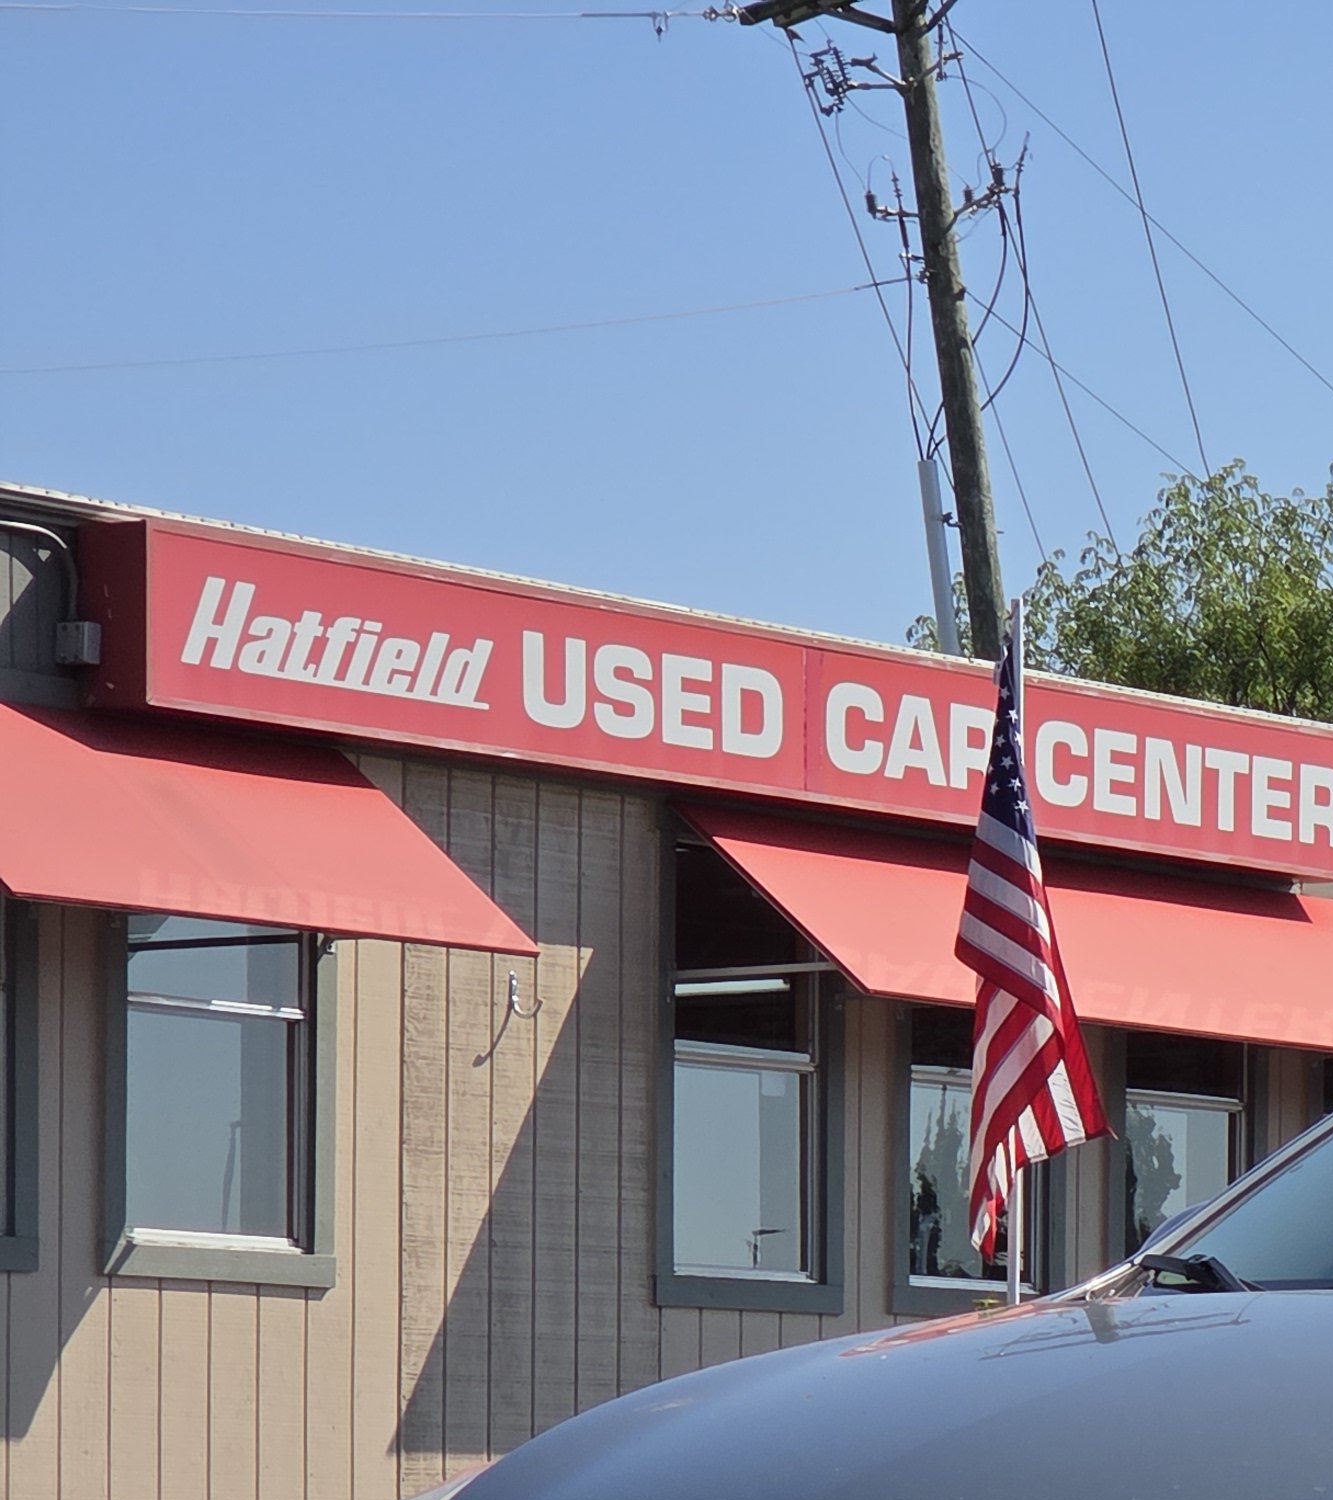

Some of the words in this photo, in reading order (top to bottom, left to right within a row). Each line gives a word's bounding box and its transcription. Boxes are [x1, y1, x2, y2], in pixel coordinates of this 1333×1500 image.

[180, 576, 494, 710] Hatfield
[522, 630, 784, 759] USED
[826, 682, 995, 790] CAR
